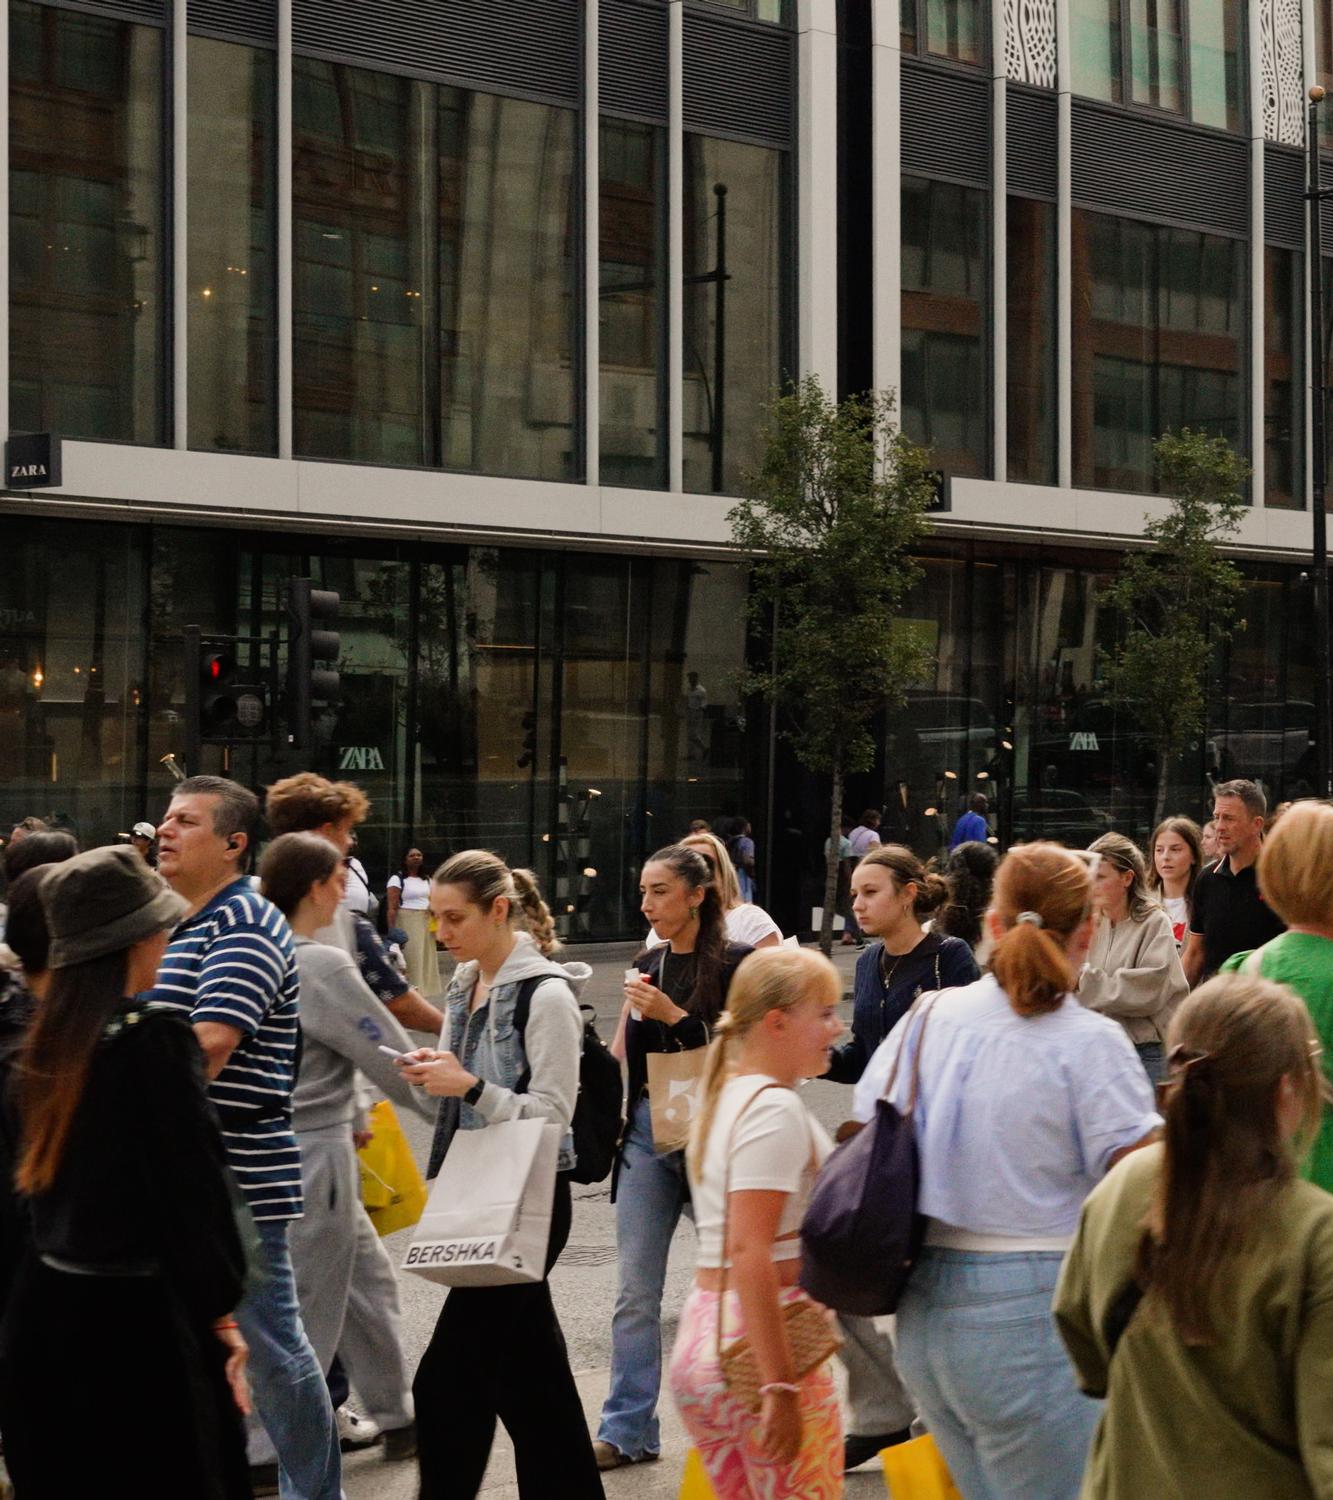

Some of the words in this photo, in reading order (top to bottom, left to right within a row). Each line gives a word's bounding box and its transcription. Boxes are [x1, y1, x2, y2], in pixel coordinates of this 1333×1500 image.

[11, 464, 47, 477] ZARA
[339, 746, 386, 770] ZARA
[406, 1241, 497, 1265] BERSHKA
